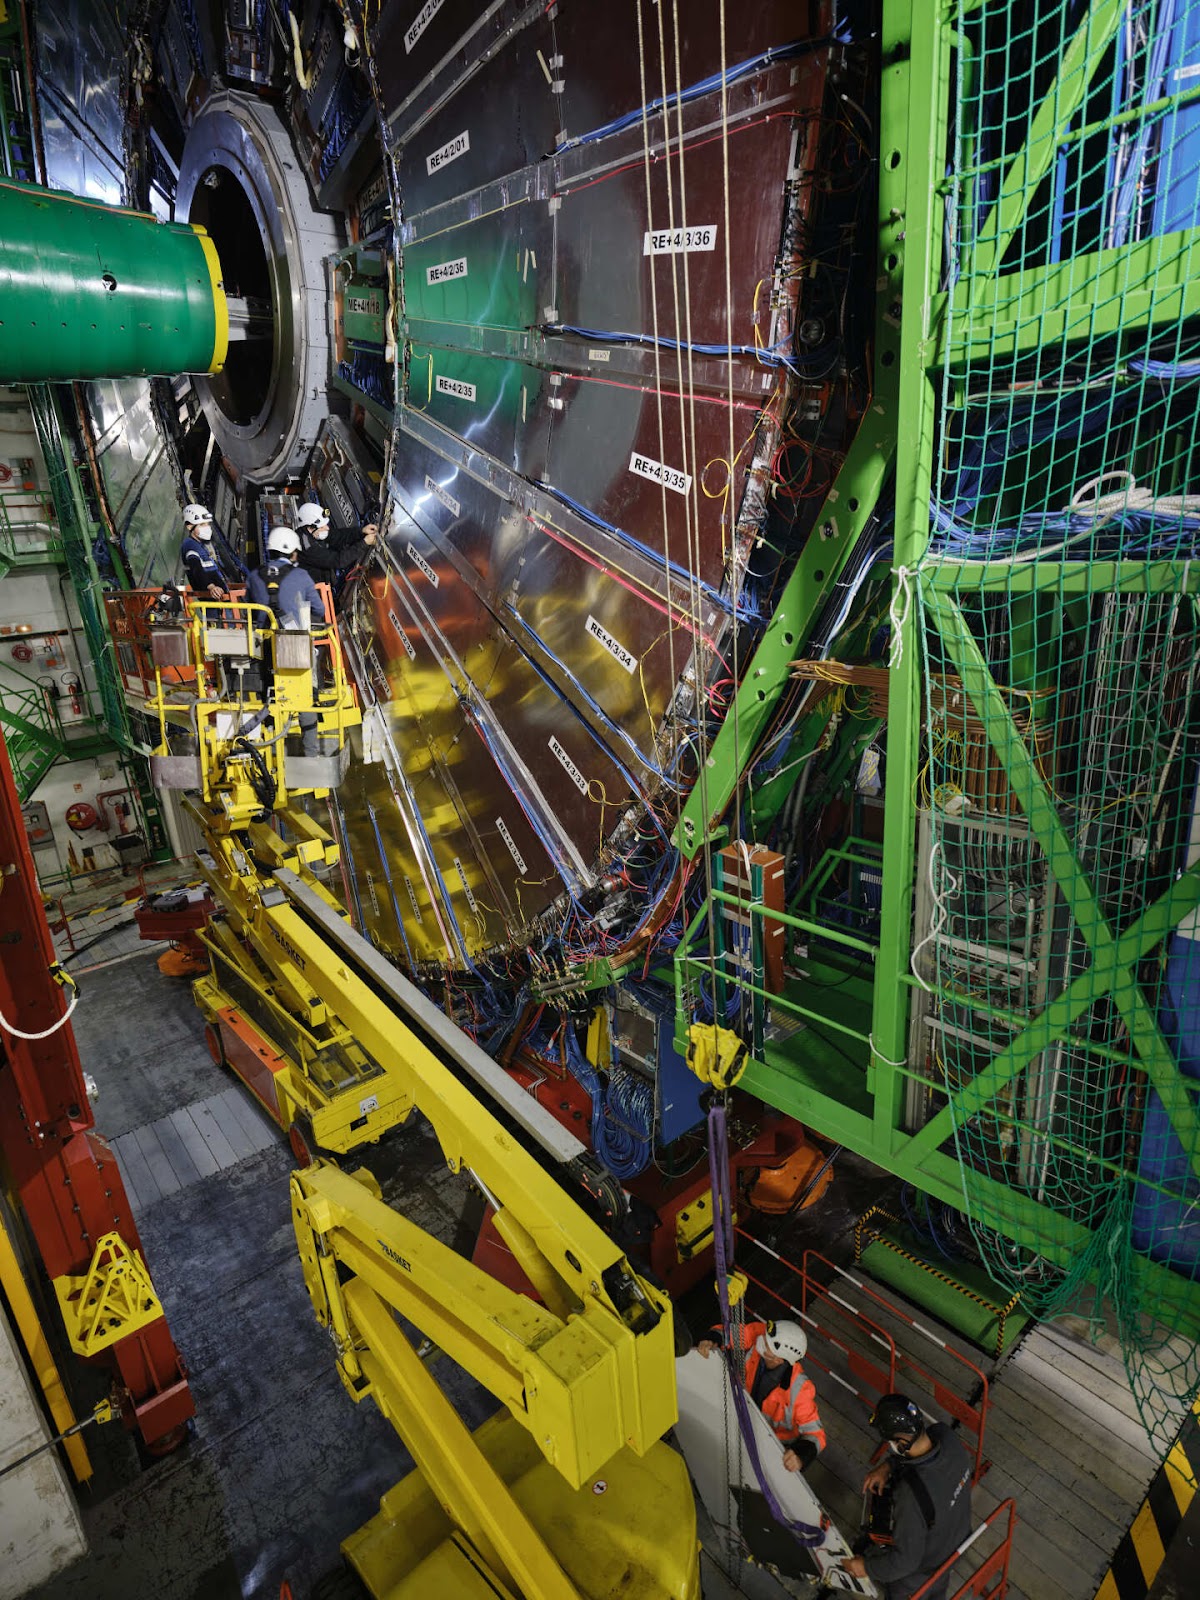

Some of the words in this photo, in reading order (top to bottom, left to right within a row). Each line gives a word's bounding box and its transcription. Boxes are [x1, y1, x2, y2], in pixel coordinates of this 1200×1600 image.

[408, 0, 441, 45] RE+4/2/0
[430, 136, 465, 169] RE+4/2/01
[651, 230, 711, 249] RE+4/3/36
[430, 261, 464, 280] RE+4/2/36
[348, 298, 380, 315] ME+4/1/18
[439, 378, 472, 397] RE+4/2/35
[409, 546, 436, 582] RE+4/2/33
[590, 621, 632, 667] RE+4/3/34
[552, 742, 586, 789] RE+4/3/33
[498, 822, 524, 869] RE+4/3/32
